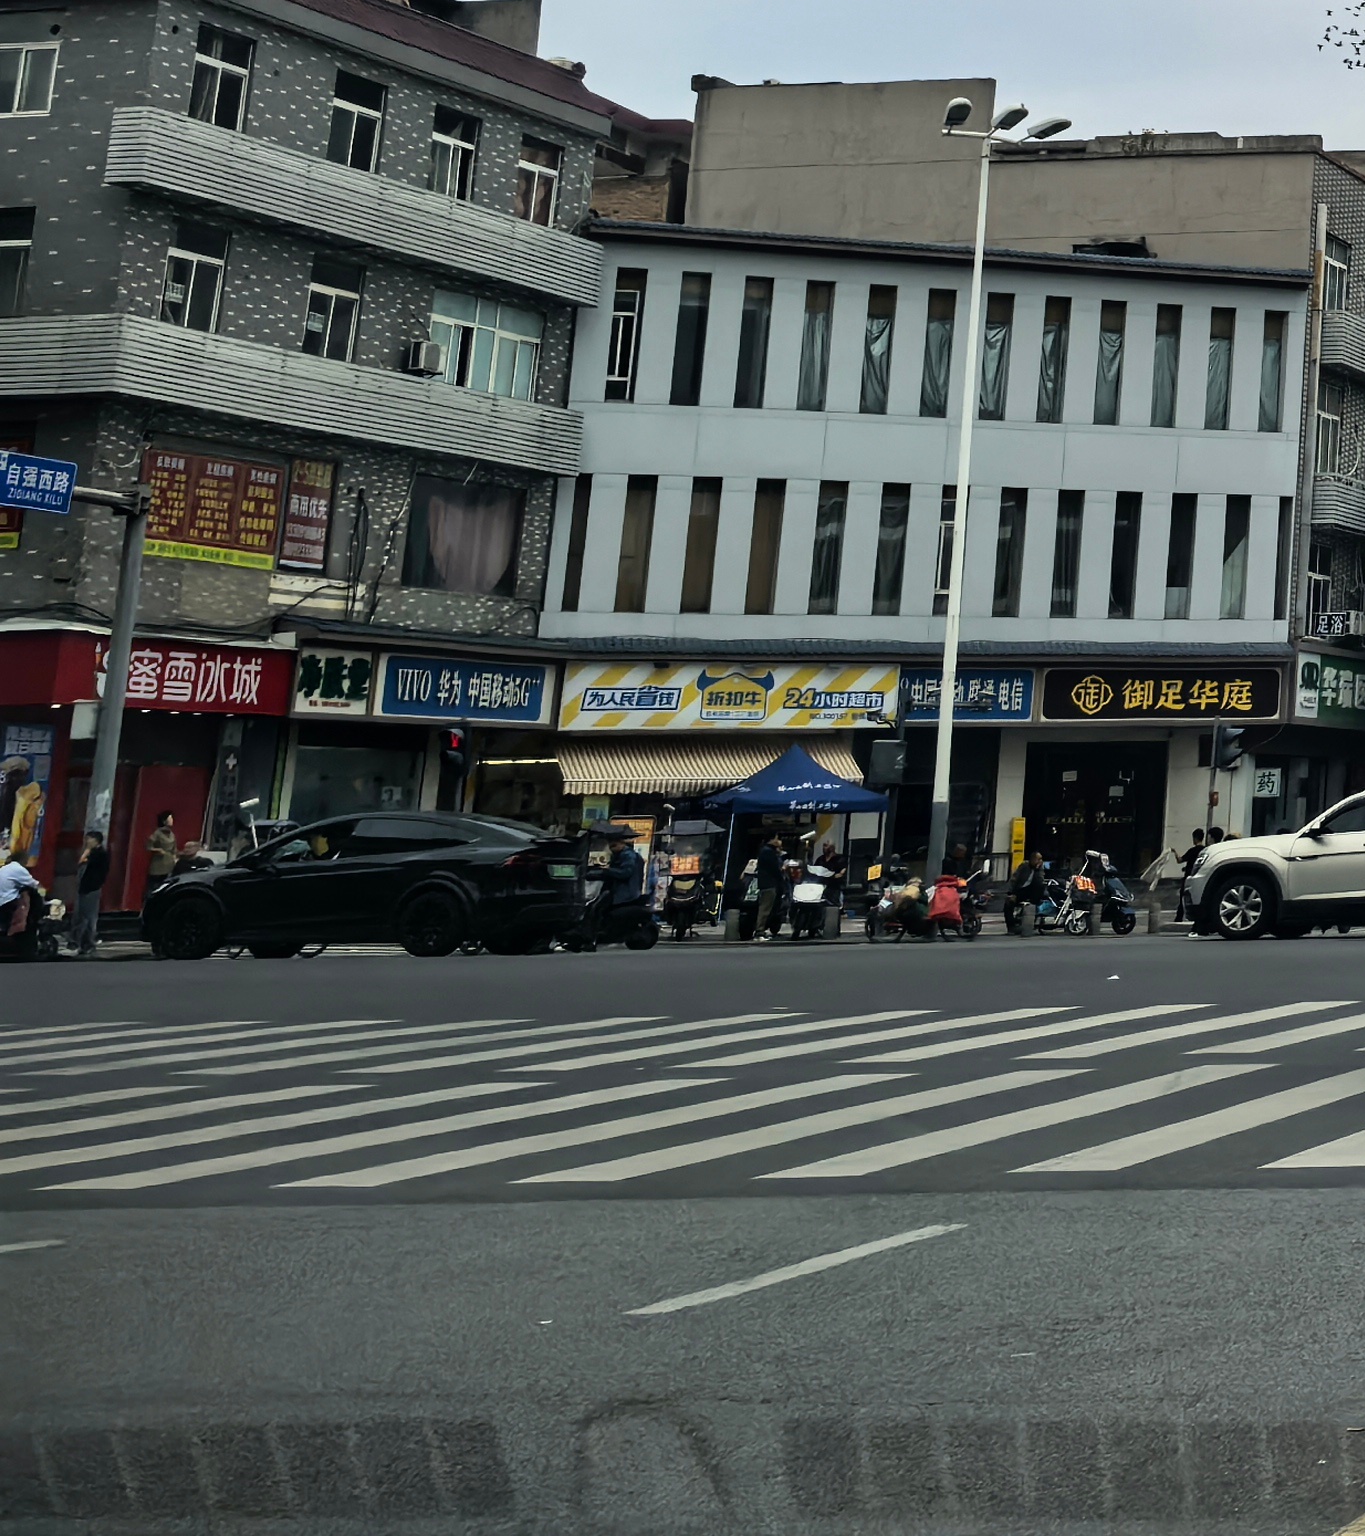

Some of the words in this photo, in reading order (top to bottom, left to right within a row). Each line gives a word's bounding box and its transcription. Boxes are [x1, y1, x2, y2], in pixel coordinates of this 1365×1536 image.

[6, 463, 70, 494] 自强西路
[1316, 615, 1344, 634] 足浴
[125, 648, 263, 706] 蜜雪冰城
[398, 668, 433, 702] VIVO
[437, 668, 462, 707] 华为
[706, 691, 763, 707] 折扣牛
[783, 688, 885, 709] 24小时超市
[998, 677, 1025, 712] 电信
[1121, 678, 1253, 711] 御足华庭
[1256, 771, 1276, 793] 药
